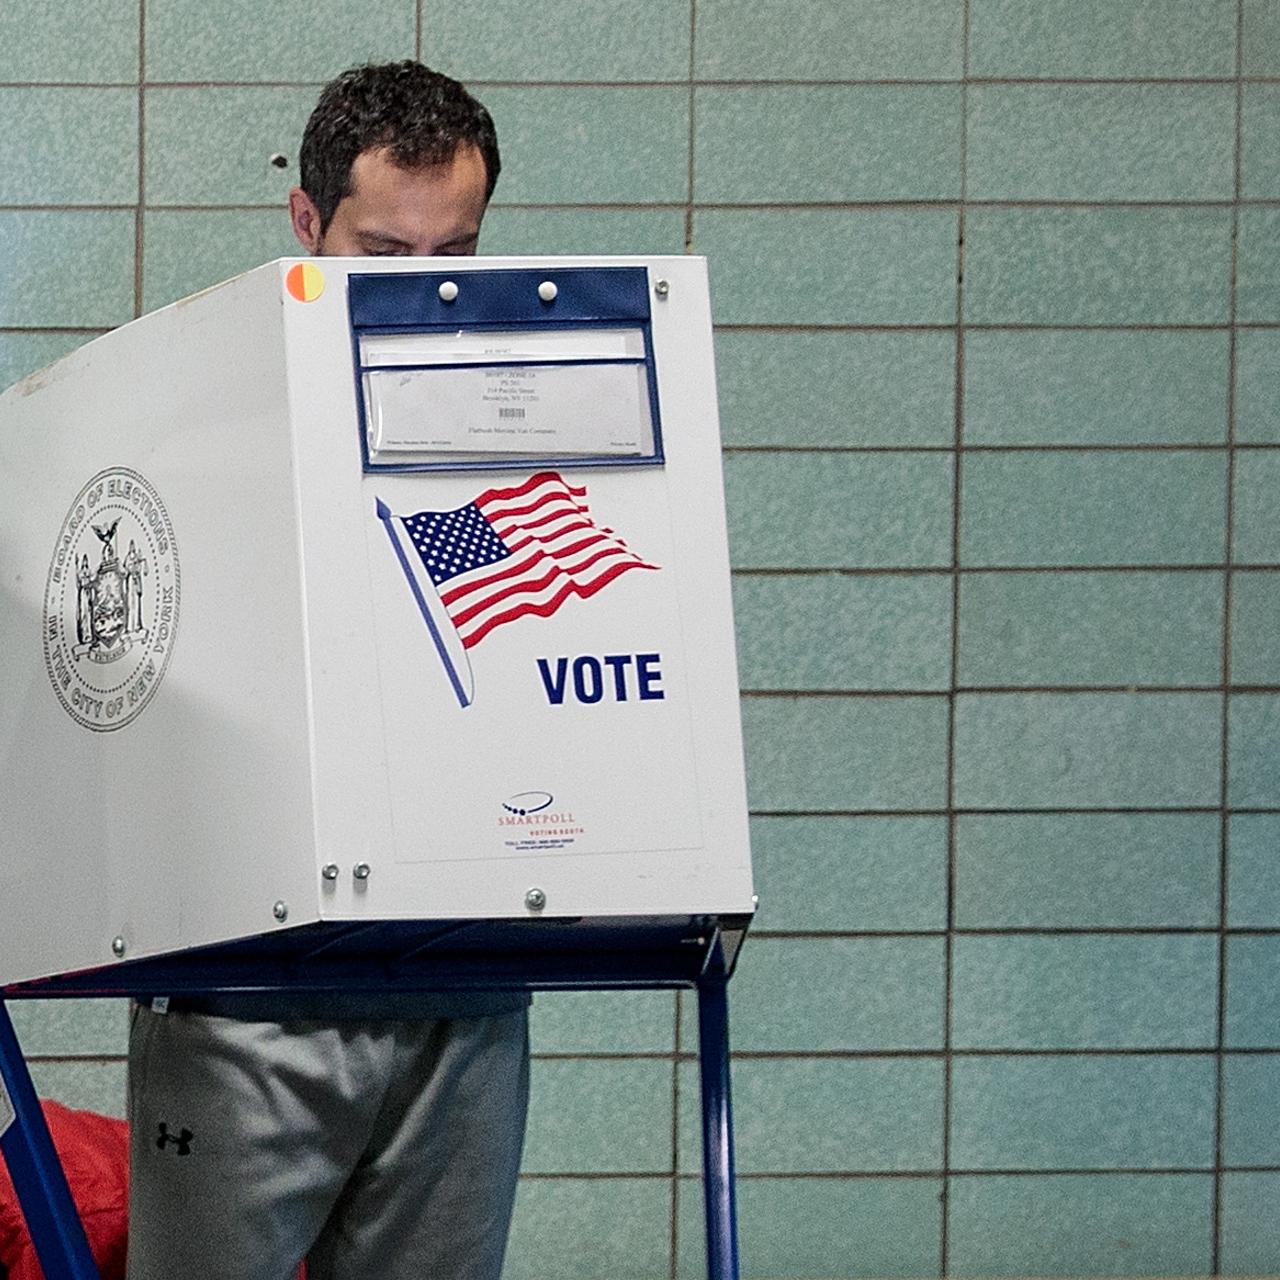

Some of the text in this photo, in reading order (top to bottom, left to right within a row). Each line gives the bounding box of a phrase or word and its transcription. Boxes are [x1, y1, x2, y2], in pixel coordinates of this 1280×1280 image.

[52, 479, 169, 583] BOARD OF ELECTIONS
[71, 687, 104, 718] CITY
[105, 696, 124, 718] OF
[126, 658, 156, 707] NEW
[153, 585, 174, 654] YORK
[536, 654, 665, 705] VOTE
[498, 813, 576, 826] SMARTPOLL
